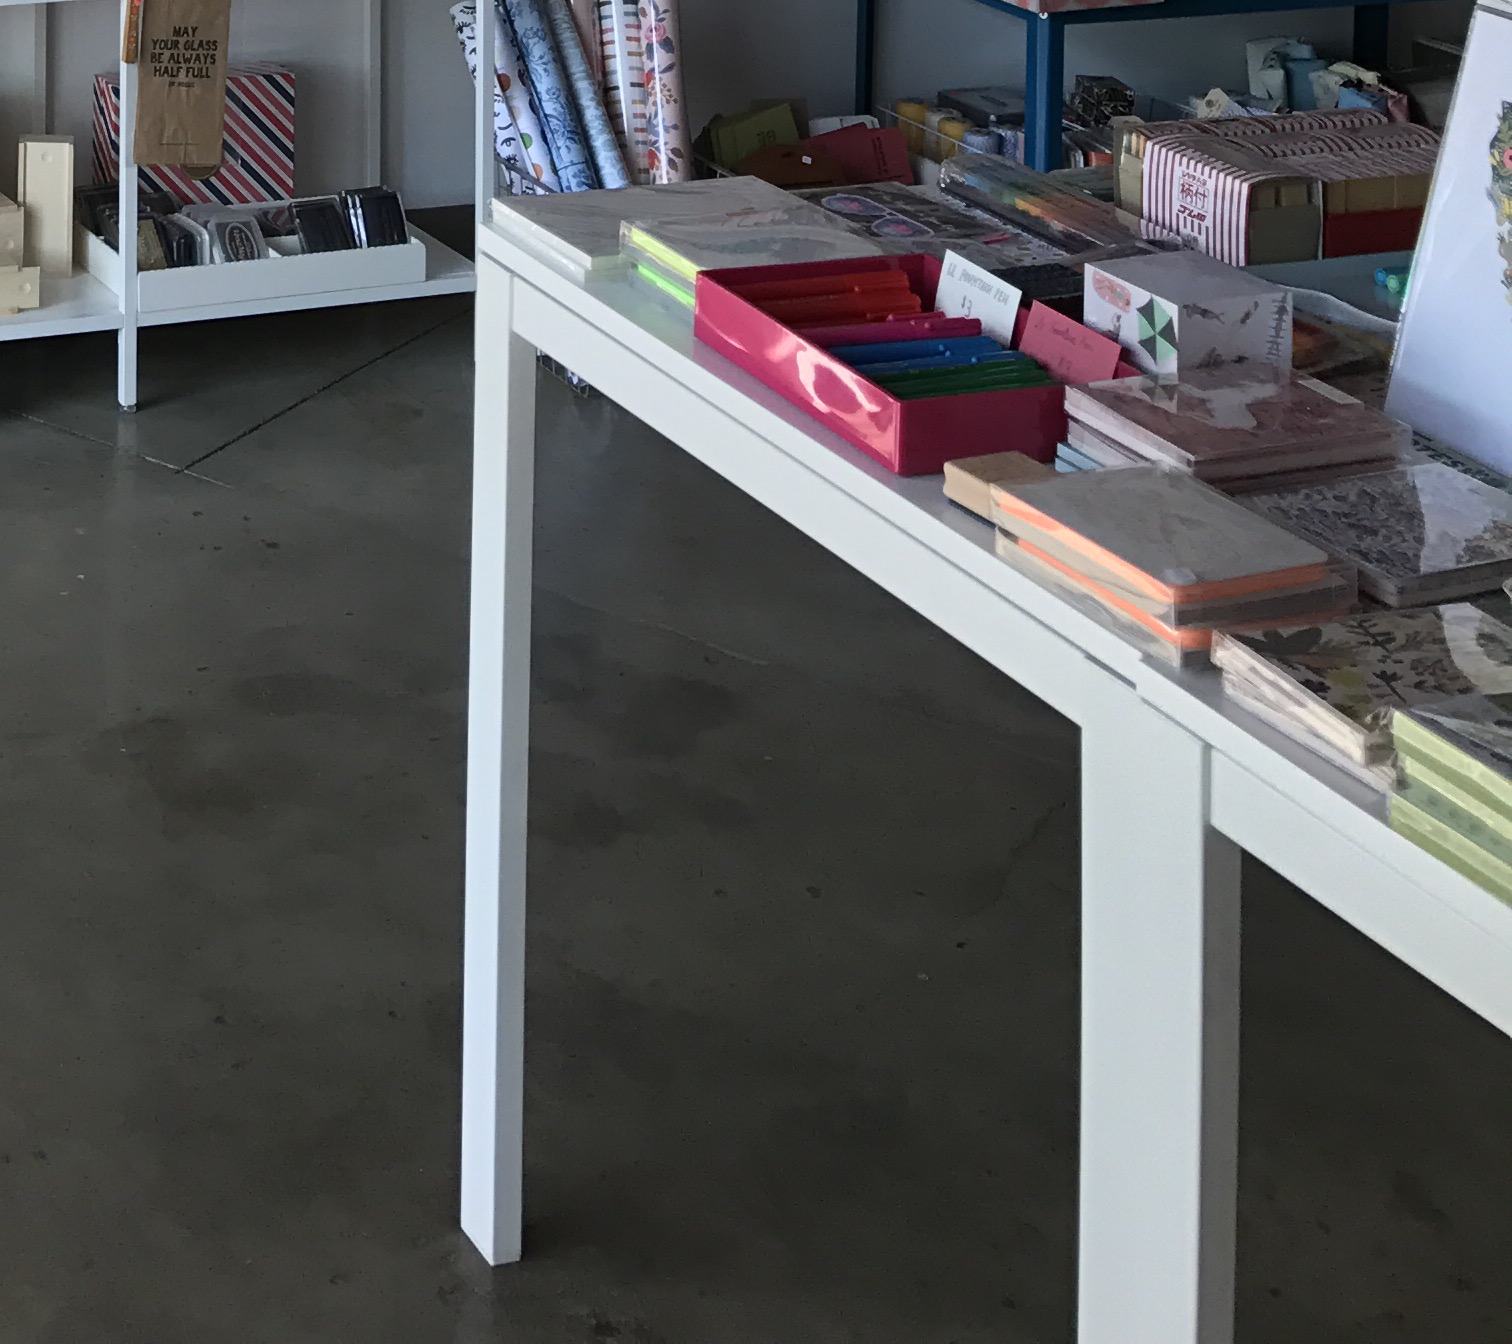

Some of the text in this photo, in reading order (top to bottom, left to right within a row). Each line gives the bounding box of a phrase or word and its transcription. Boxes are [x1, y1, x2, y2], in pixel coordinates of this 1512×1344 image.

[172, 25, 198, 38] MAY
[151, 39, 218, 52] YOUR GLASS
[150, 53, 217, 66] BE ALWAYS
[153, 66, 211, 79] HALF FULL
